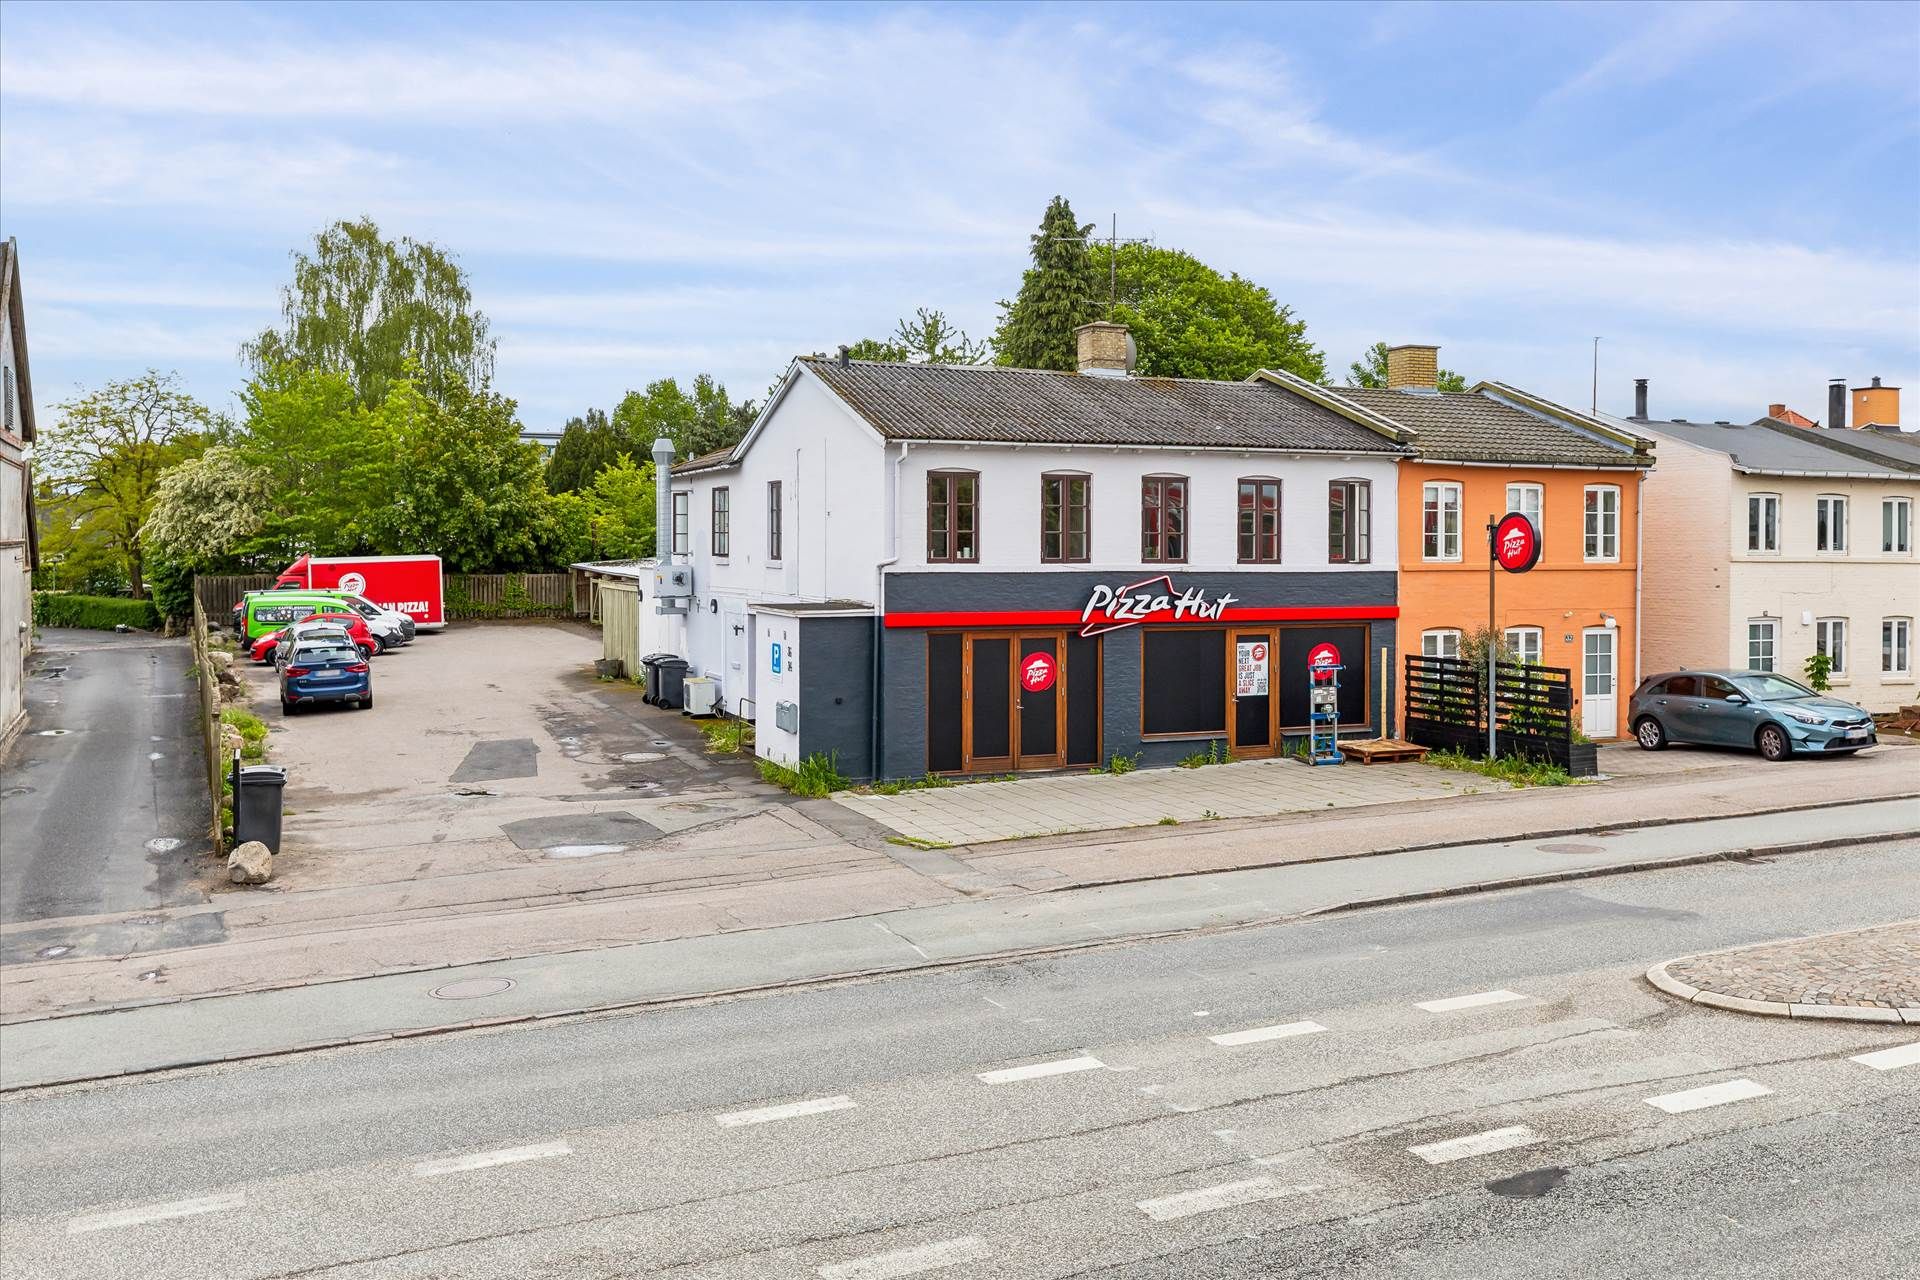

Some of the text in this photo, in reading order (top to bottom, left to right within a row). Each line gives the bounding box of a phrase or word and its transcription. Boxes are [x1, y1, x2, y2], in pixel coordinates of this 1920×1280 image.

[1503, 539, 1525, 554] Pizza
[1507, 547, 1522, 559] Hut
[397, 601, 429, 613] PIZZA!
[1082, 585, 1239, 622] Pizza Hut
[774, 646, 779, 665] P
[1026, 668, 1048, 680] Pizza
[1030, 674, 1047, 685] Hut
